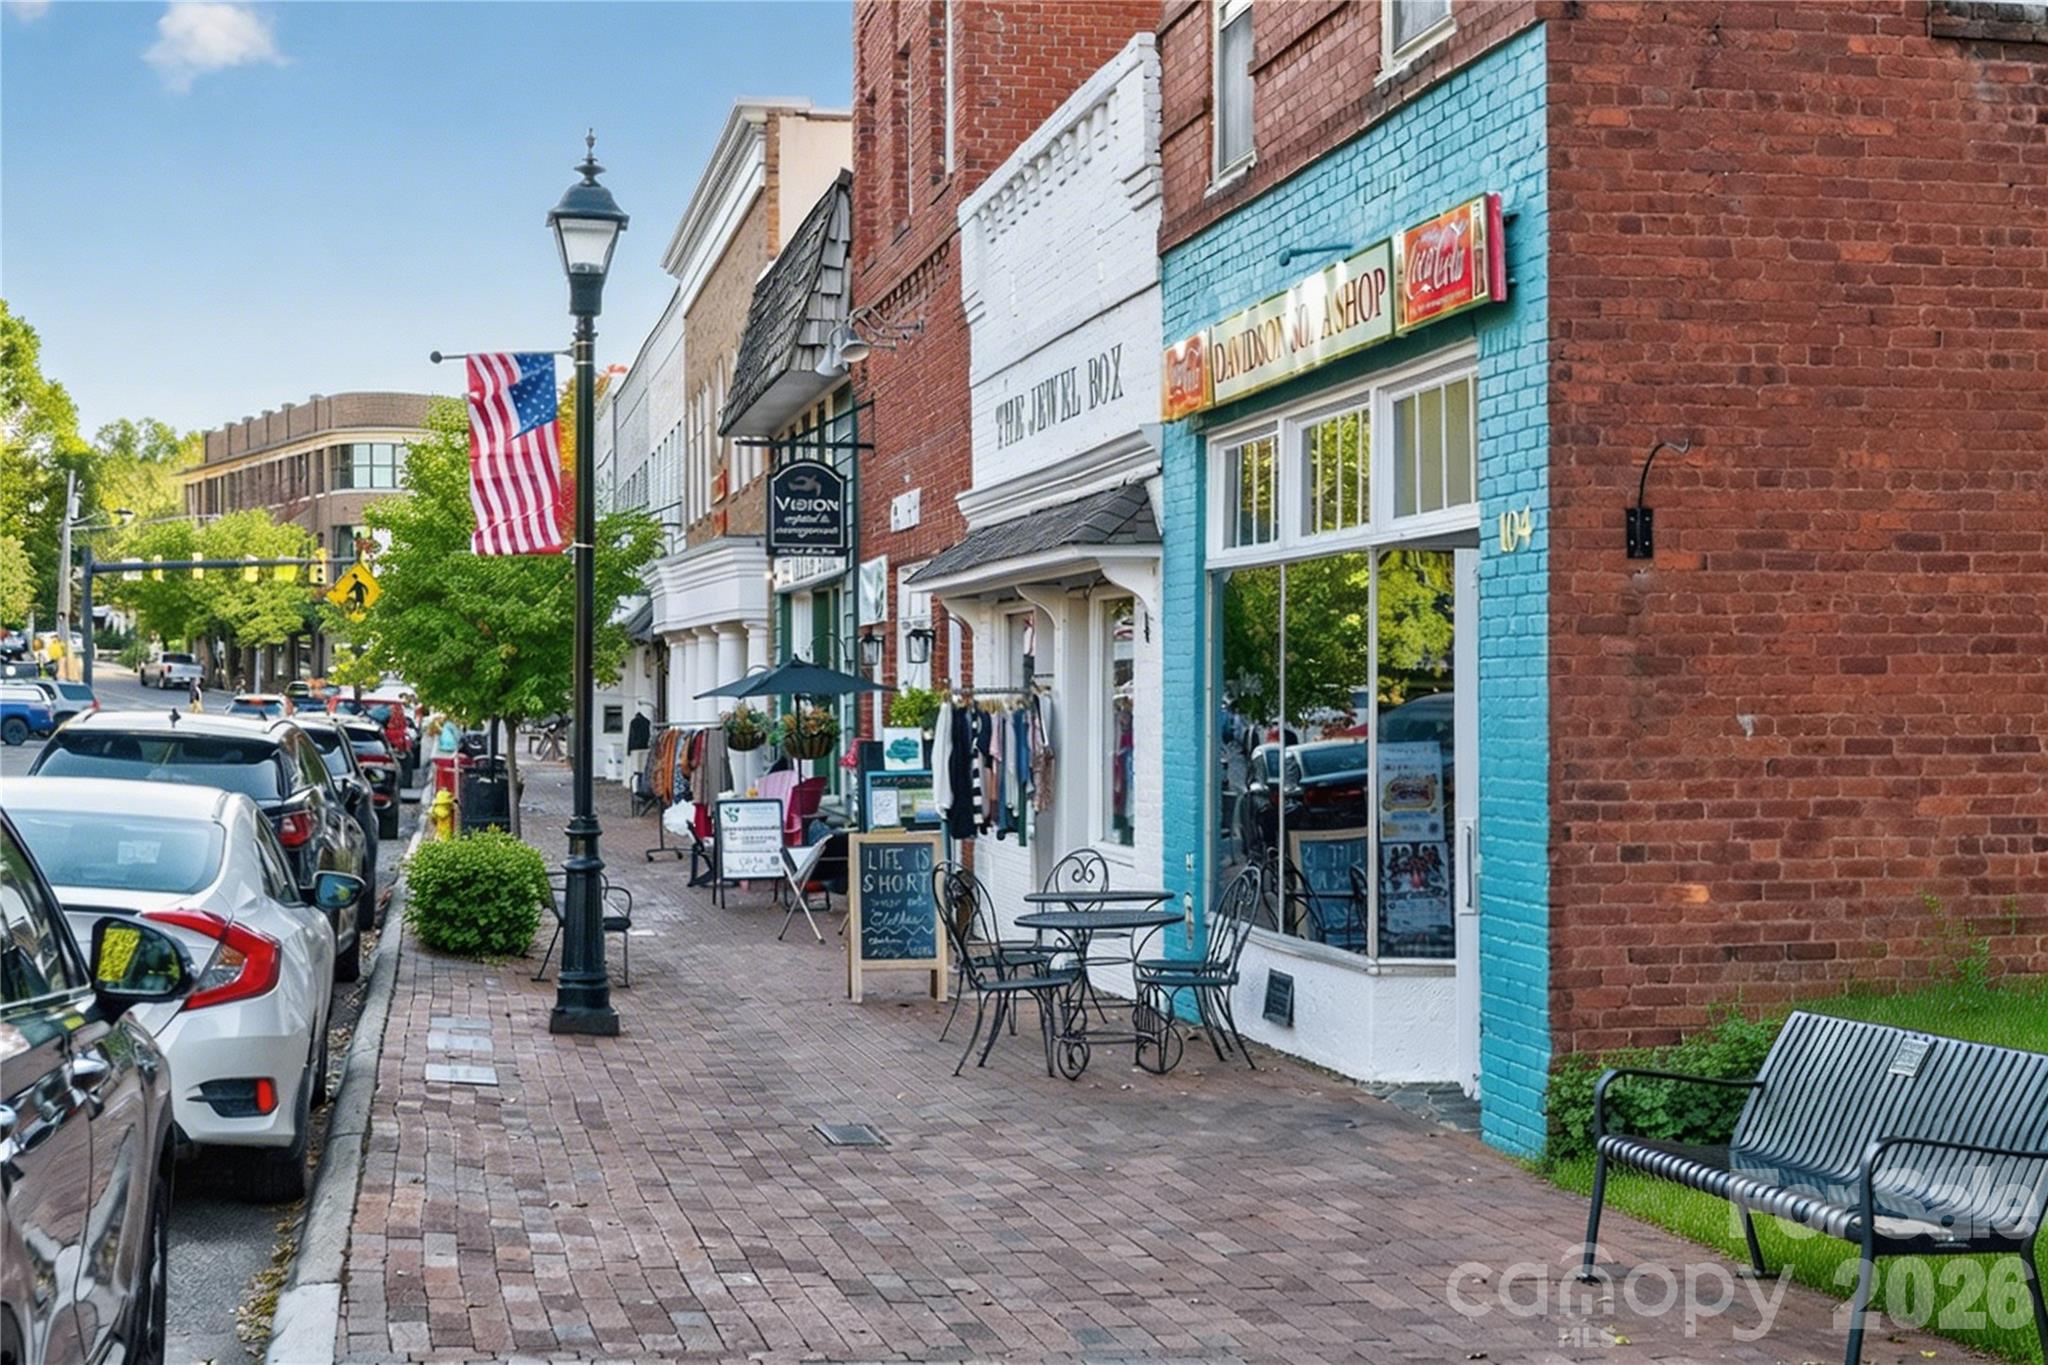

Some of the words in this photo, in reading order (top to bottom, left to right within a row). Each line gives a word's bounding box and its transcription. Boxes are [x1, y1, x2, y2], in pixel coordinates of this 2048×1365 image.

[1335, 267, 1386, 334] SHOP
[996, 394, 1025, 450] THE
[1028, 366, 1081, 436] JEWEL
[1087, 342, 1124, 411] BOX
[1500, 505, 1532, 552] 104
[868, 848, 904, 870] LIFE
[916, 847, 930, 870] IS
[863, 872, 930, 894] SHORT
